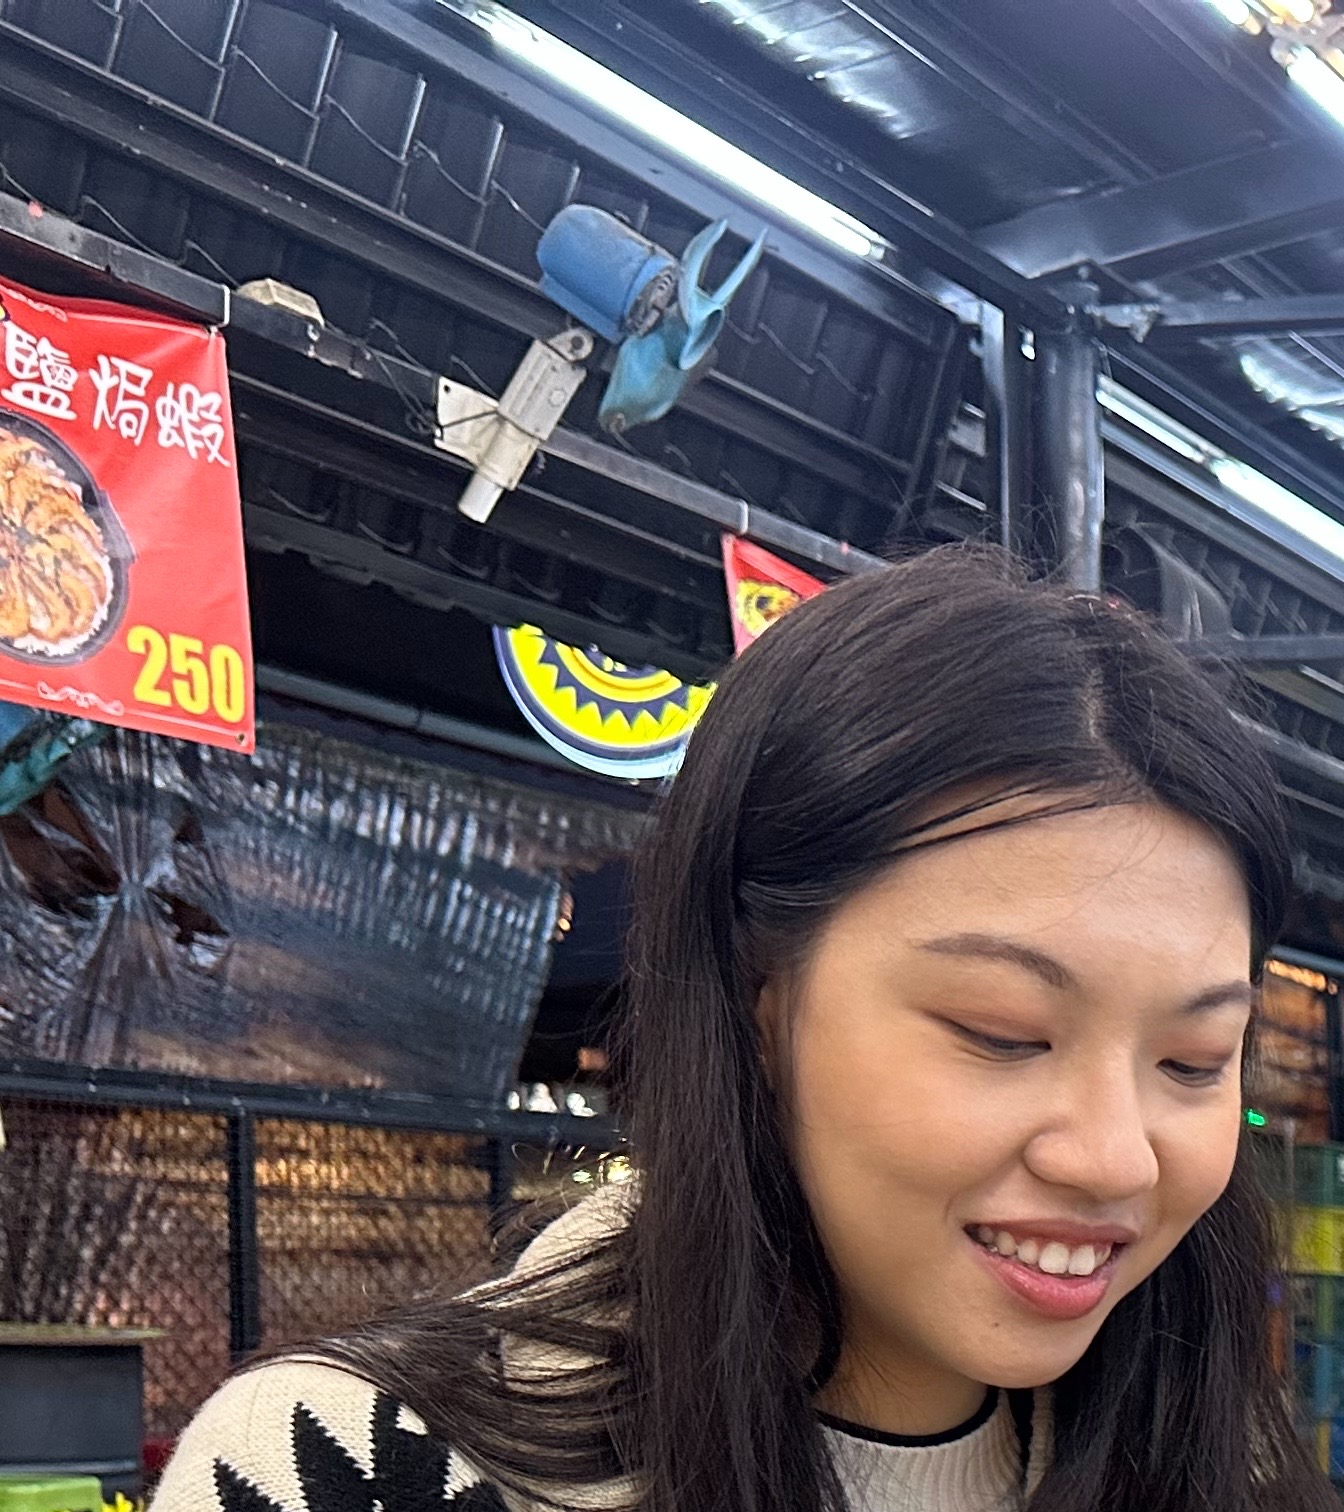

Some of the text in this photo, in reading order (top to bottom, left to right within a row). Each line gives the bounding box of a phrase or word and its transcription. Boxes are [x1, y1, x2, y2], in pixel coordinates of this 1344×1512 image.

[1, 320, 232, 468] 鹽焗蝦
[126, 624, 246, 724] 250
